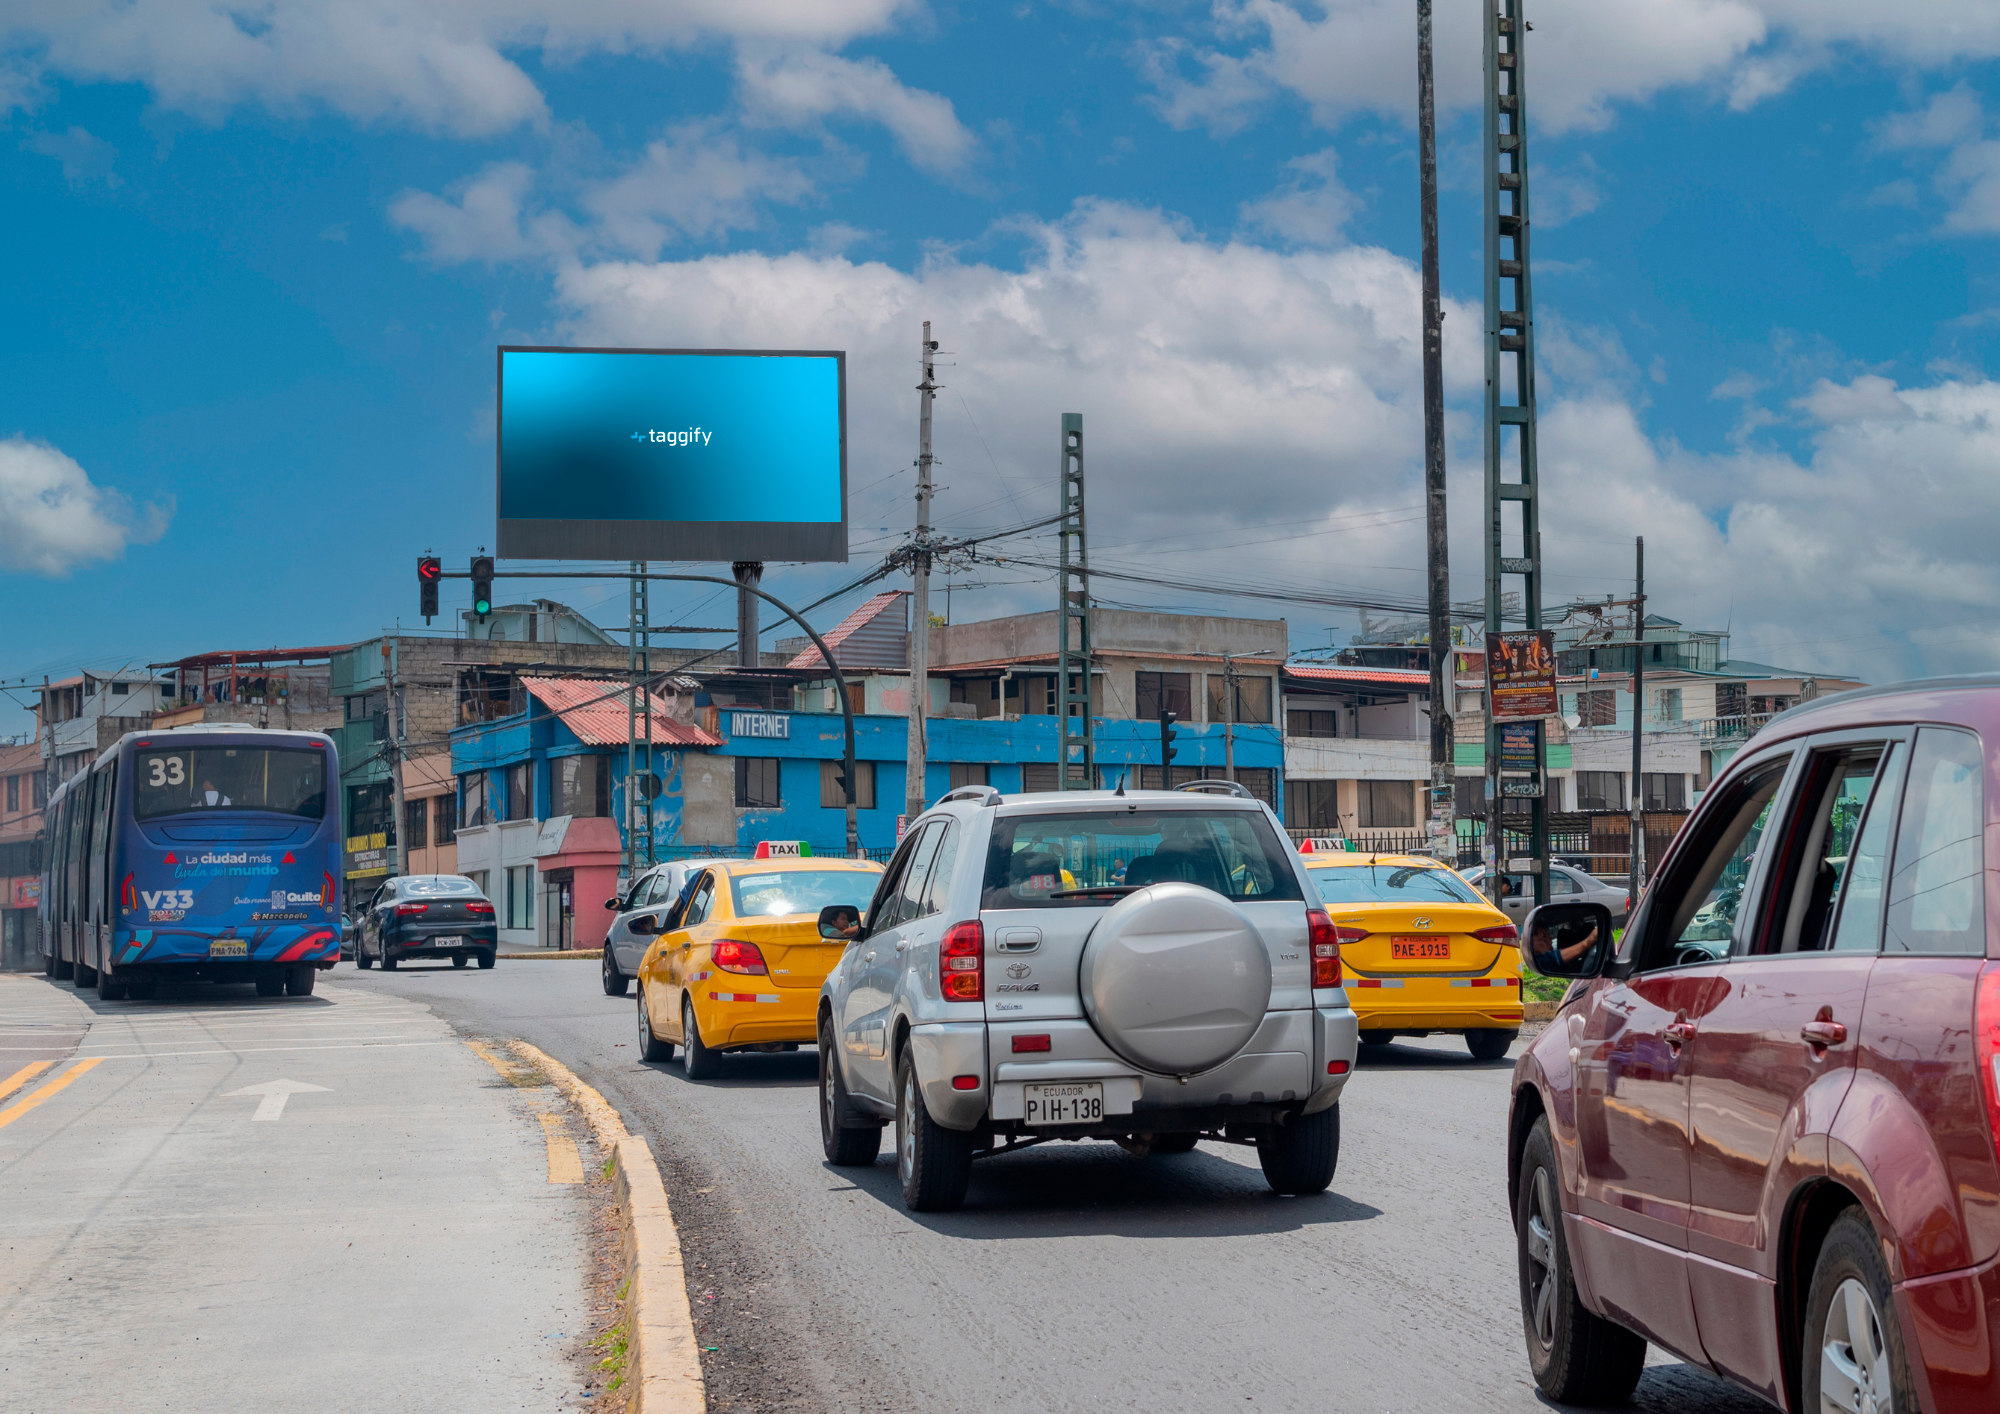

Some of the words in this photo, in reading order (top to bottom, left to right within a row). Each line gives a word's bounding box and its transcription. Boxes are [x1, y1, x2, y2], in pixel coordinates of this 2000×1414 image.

[648, 427, 712, 446] taggify
[1502, 634, 1528, 642] NOCHE
[732, 713, 790, 737] INTERNET
[148, 756, 185, 787] 33
[769, 844, 800, 855] TAXI
[1311, 839, 1346, 850] TAXI
[185, 855, 198, 865] La
[200, 852, 247, 864] ciudad
[249, 853, 272, 864] más
[174, 863, 208, 879] linda
[210, 866, 227, 877] del
[228, 864, 280, 876] mundo
[140, 889, 194, 909] V33
[286, 891, 322, 903] Quito
[261, 912, 309, 920] Marcopolo
[1393, 944, 1448, 957] PAE-1915
[996, 982, 1040, 993] RAV4
[1043, 1087, 1084, 1097] ECUADOR
[1027, 1098, 1102, 1121] PIH-138
